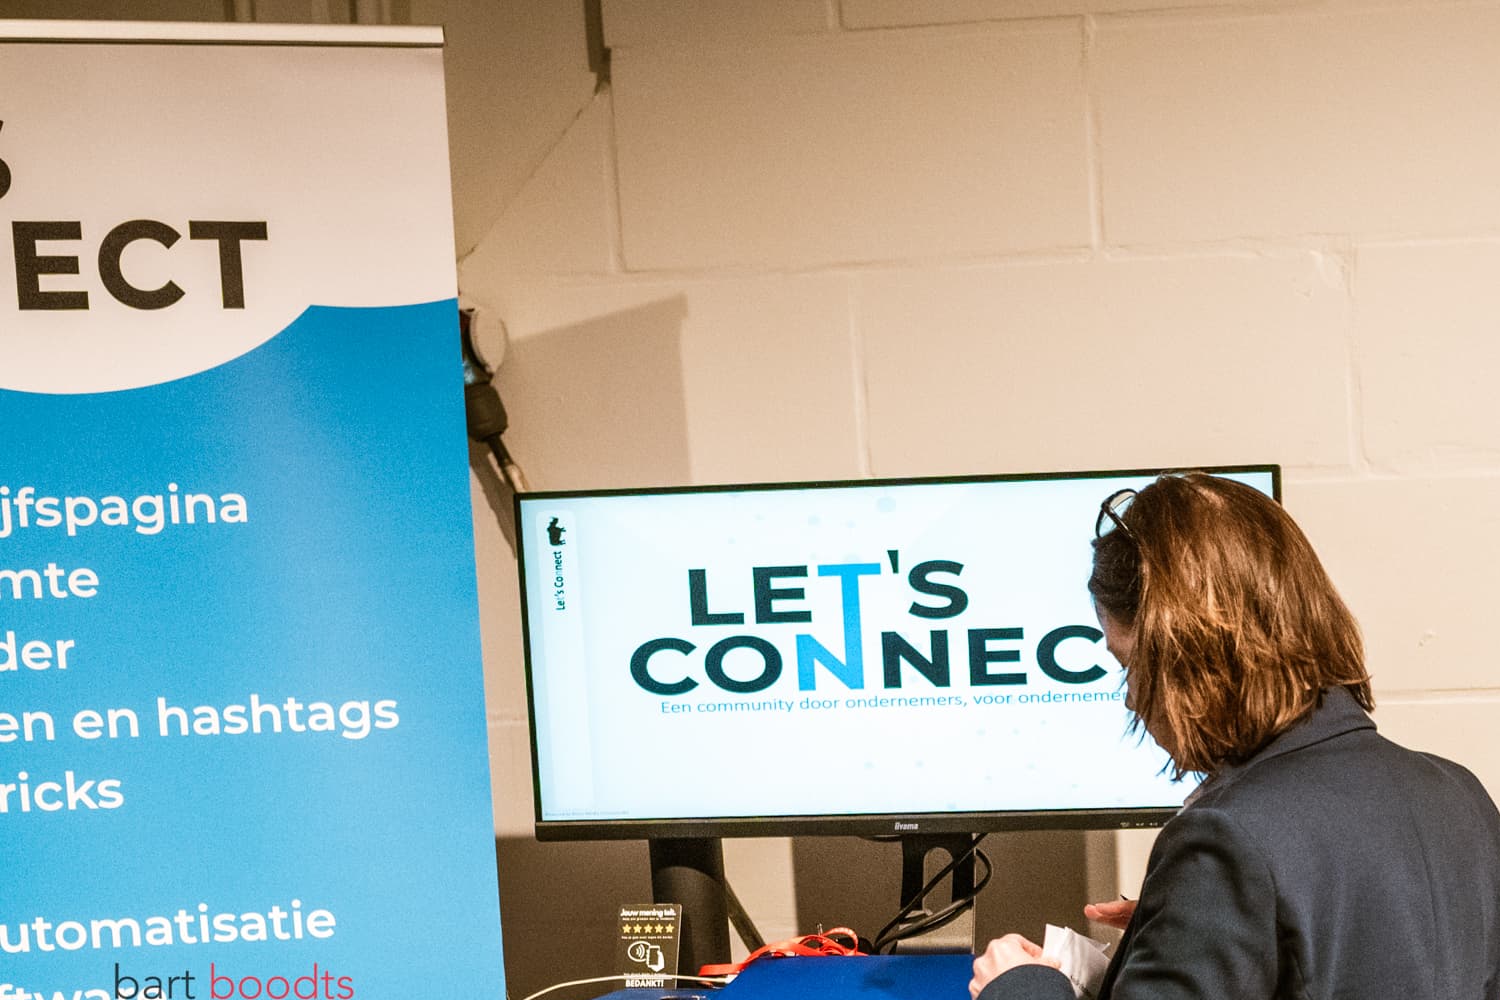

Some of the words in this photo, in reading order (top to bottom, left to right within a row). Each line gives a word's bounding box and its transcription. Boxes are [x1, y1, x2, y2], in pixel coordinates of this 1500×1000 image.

[12, 219, 268, 310] ECT
[0, 483, 248, 537] jfspagina
[0, 562, 99, 600] mte
[688, 549, 969, 626] LET'S
[0, 631, 75, 671] der
[73, 707, 139, 740] en
[157, 694, 400, 740] hashtags
[661, 701, 691, 713] Een
[697, 697, 794, 713] community
[800, 696, 840, 710] door
[845, 693, 968, 709] ondernemers,
[973, 694, 1011, 705] voor
[0, 771, 124, 812] ricks
[0, 899, 336, 953] utomatisatie
